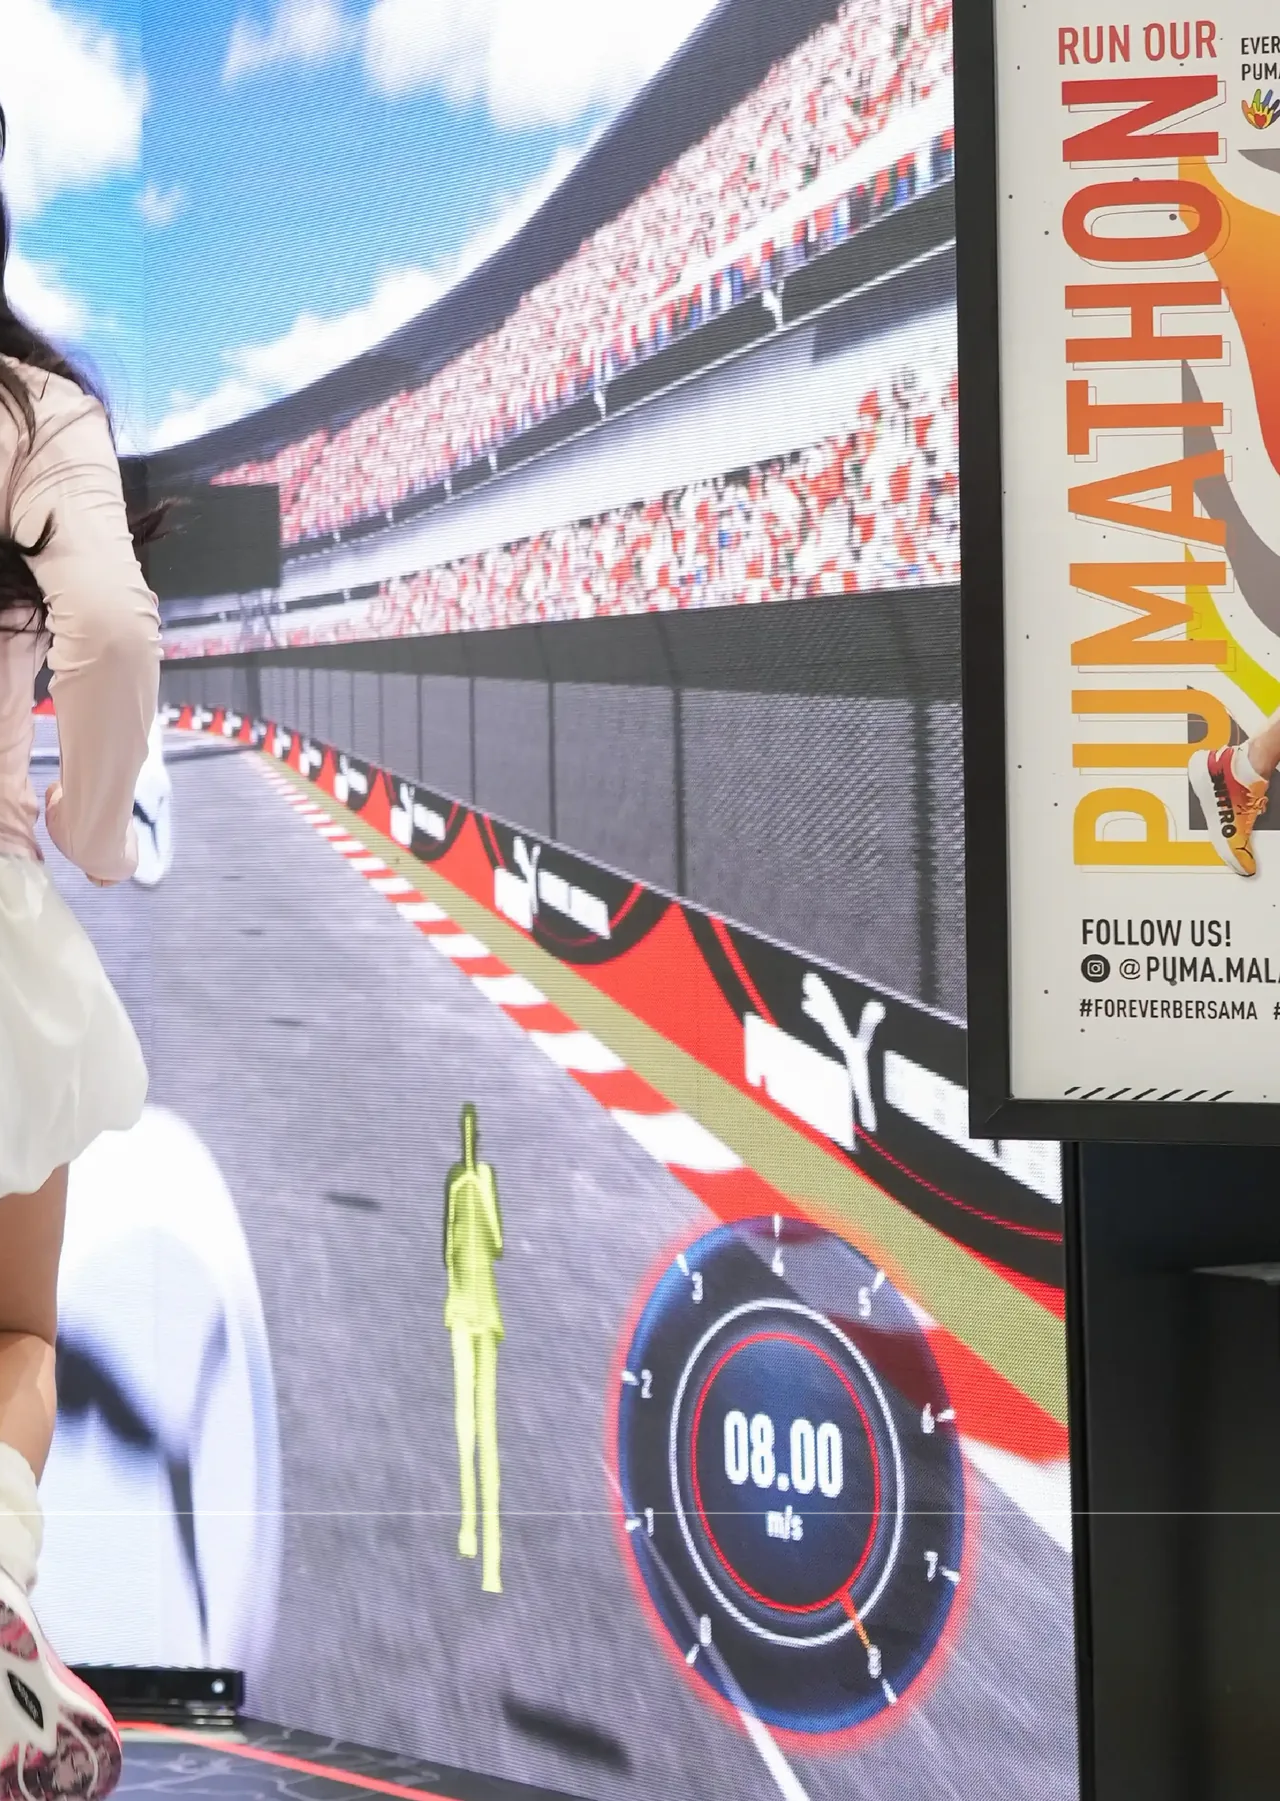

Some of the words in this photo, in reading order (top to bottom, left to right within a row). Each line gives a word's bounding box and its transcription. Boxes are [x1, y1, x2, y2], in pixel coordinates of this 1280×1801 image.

[1058, 24, 1131, 65] RUN
[1144, 20, 1218, 62] OUR
[1241, 62, 1280, 81] PUM
[1061, 75, 1231, 866] PUMATHON
[1081, 918, 1182, 947] FOLLOW
[1190, 920, 1231, 948] US!
[1119, 956, 1280, 984] @PUMA.MAL
[1079, 998, 1258, 1020] #FOREVERBERSAMA
[641, 1369, 653, 1399] 2
[920, 1402, 935, 1434] 6
[723, 1410, 844, 1498] 08.00
[644, 1507, 654, 1537] 1
[765, 1504, 804, 1541] m/s
[924, 1550, 938, 1582] 7
